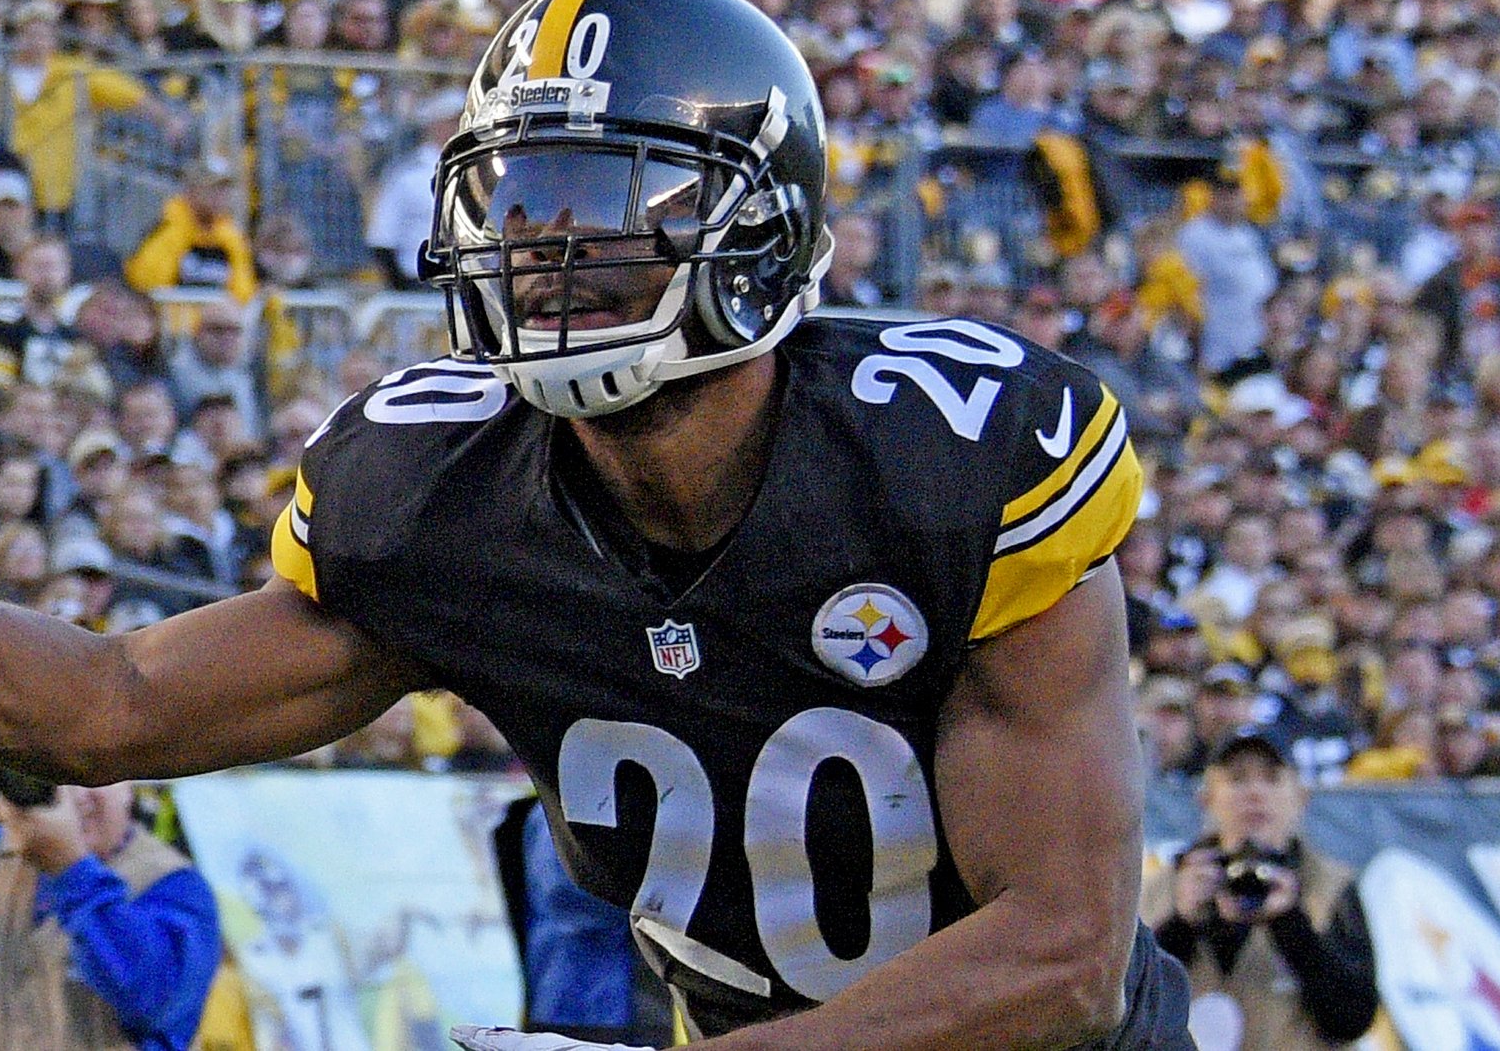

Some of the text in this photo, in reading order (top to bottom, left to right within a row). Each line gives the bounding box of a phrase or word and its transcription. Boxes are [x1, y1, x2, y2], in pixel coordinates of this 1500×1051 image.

[510, 83, 572, 107] Steelers
[850, 319, 1026, 442] 20
[821, 627, 866, 641] Steelers
[658, 645, 694, 669] NFL
[557, 706, 938, 1004] 20
